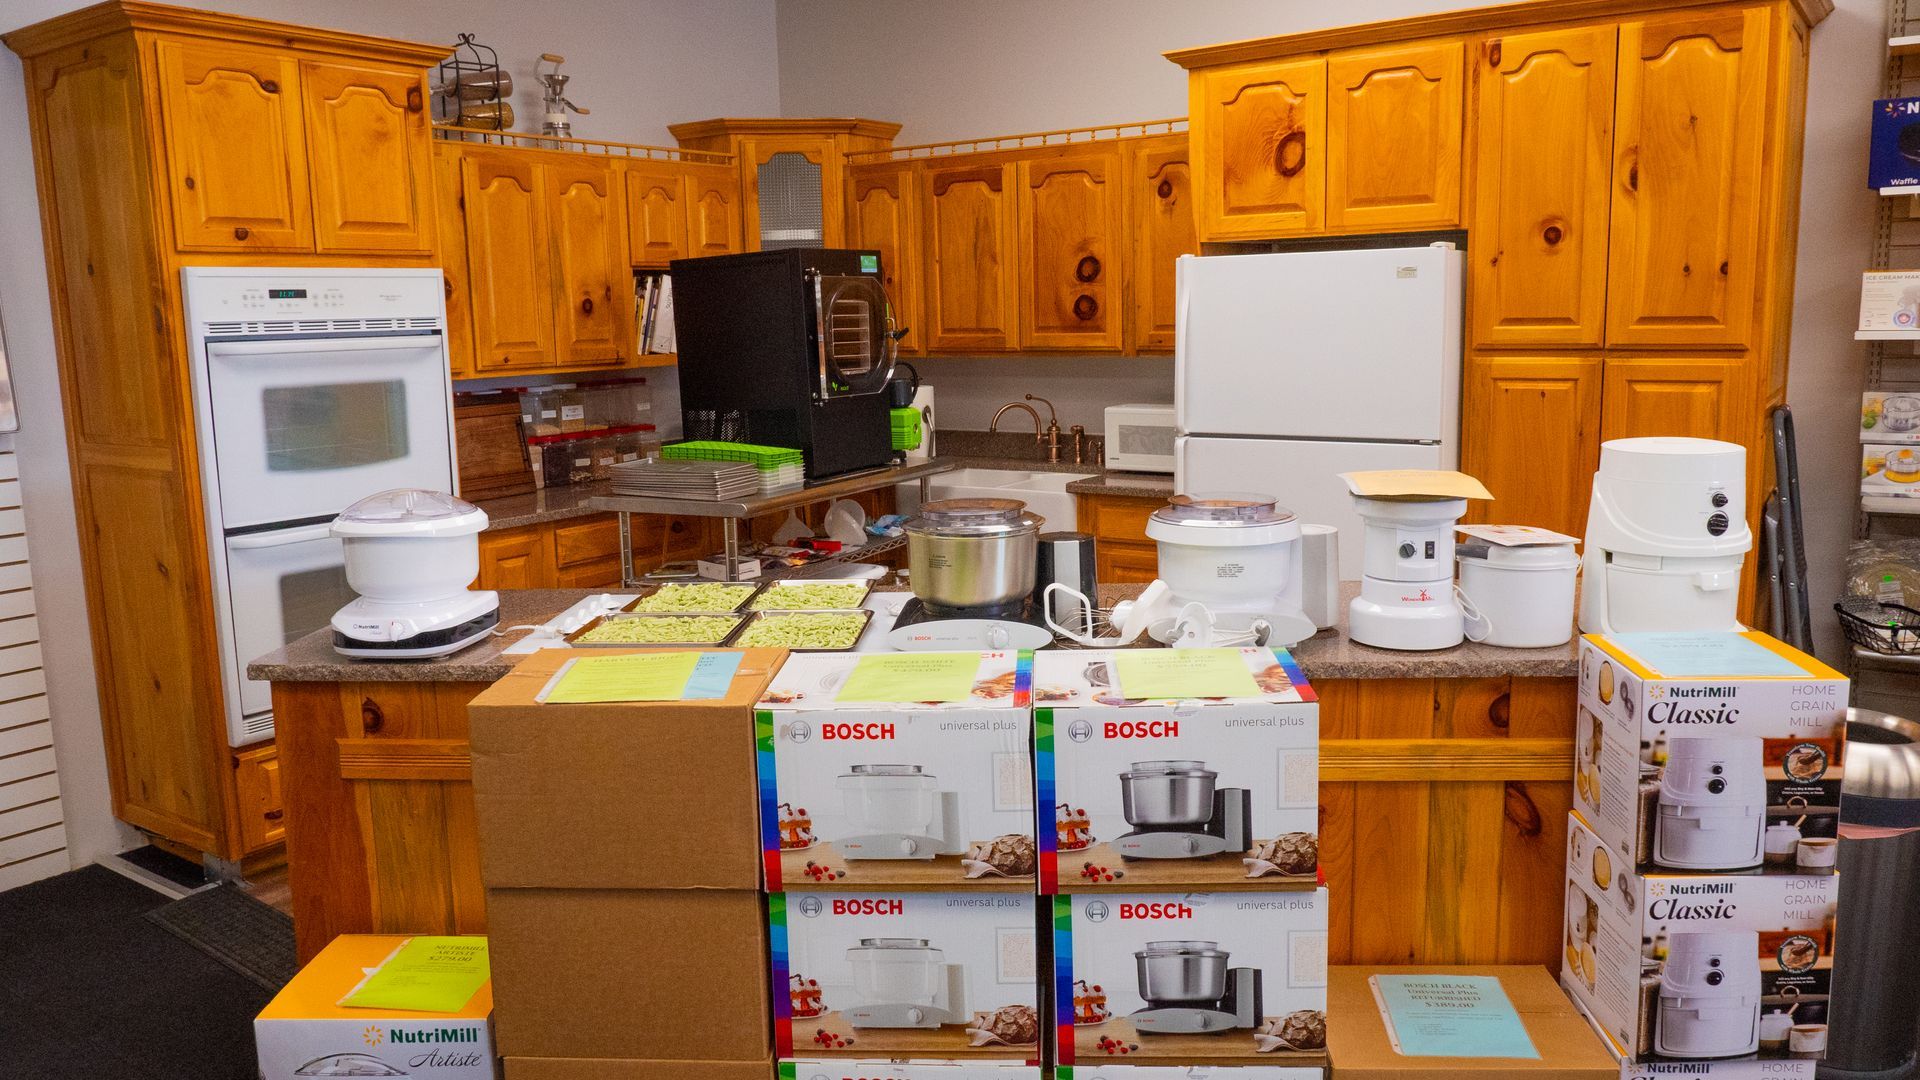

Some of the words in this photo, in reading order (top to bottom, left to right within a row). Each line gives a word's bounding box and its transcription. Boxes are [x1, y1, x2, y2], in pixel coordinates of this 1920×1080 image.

[1890, 178, 1918, 186] Waffle
[1670, 686, 1736, 698] NutriMill
[1792, 685, 1836, 696] HOME
[1648, 702, 1740, 725] Classic
[1790, 701, 1836, 711] GRAIN
[822, 723, 895, 740] BOSCH
[939, 719, 990, 732] universal
[993, 720, 1017, 732] plus
[1104, 721, 1179, 739] BOSCH
[1225, 716, 1276, 728] universal
[1279, 716, 1304, 728] plus
[1790, 717, 1822, 727] MILL
[1670, 883, 1733, 895] NutriMill
[1785, 880, 1828, 890] HOME
[833, 899, 903, 916] BOSCH
[946, 896, 994, 908] universal
[997, 897, 1021, 909] plus
[1120, 902, 1192, 919] BOSCH
[1237, 900, 1287, 911] universal
[1290, 899, 1314, 911] plus
[1649, 898, 1737, 920] Classic
[1784, 894, 1826, 906] GRAIN
[1783, 910, 1815, 920] MILL
[390, 1028, 478, 1043] NutriMill
[408, 1048, 481, 1068] Artiste
[1647, 1063, 1710, 1074] NutriMill
[1761, 1063, 1804, 1073] HOME
